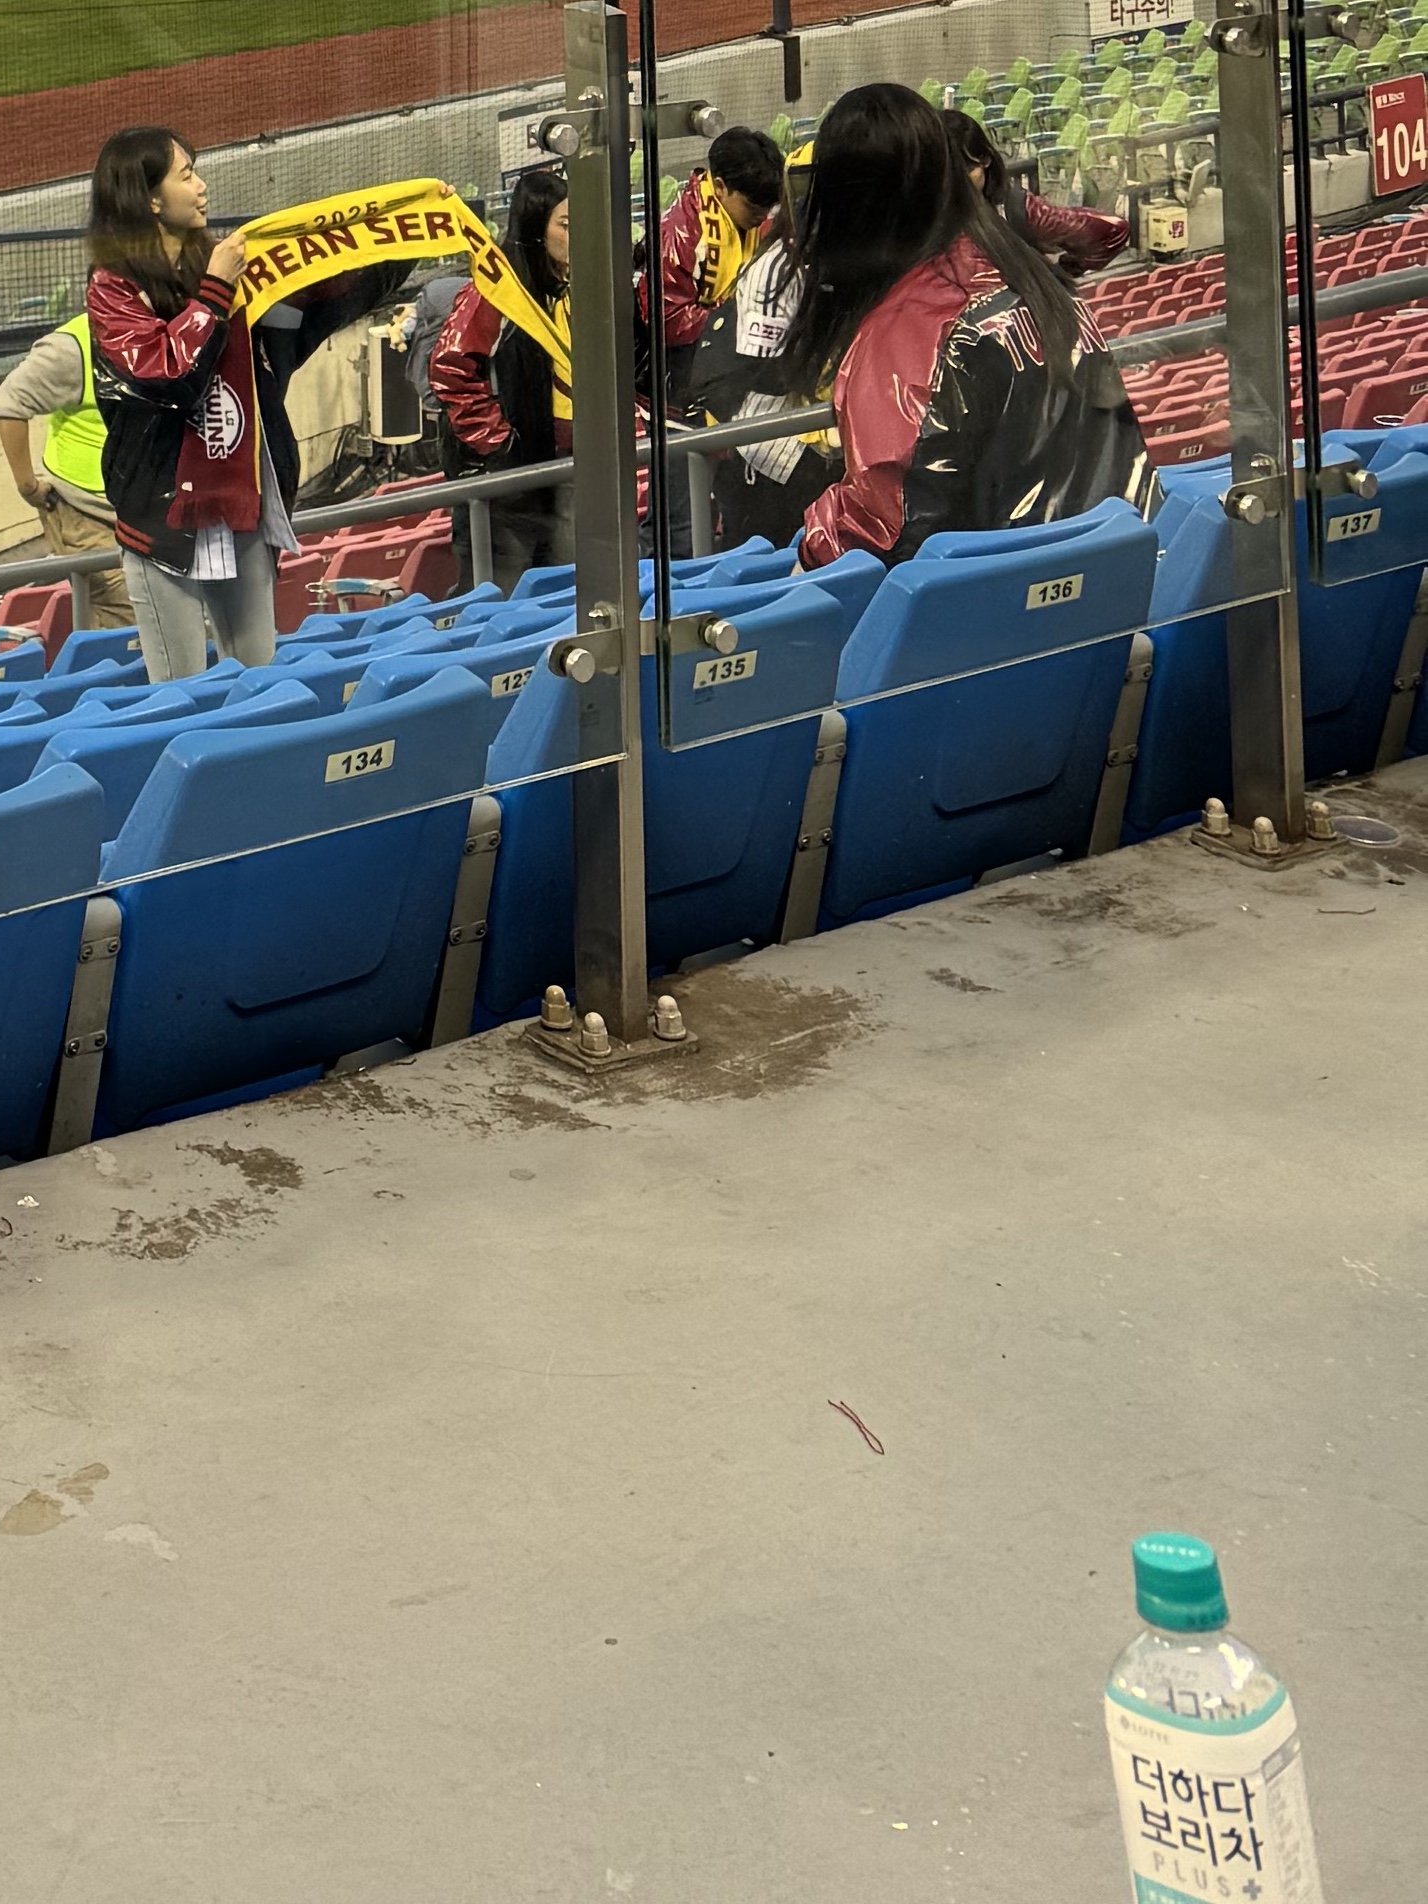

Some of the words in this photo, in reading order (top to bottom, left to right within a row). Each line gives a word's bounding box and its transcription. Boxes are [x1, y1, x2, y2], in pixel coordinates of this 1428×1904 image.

[1376, 118, 1428, 181] 104
[1337, 511, 1374, 538] 137
[1038, 579, 1074, 605] 136
[706, 653, 748, 682] 135
[339, 746, 384, 776] 134
[1131, 1752, 1256, 1823] 더하다
[1140, 1800, 1264, 1871] 보리차
[1152, 1852, 1232, 1898] PLUS
